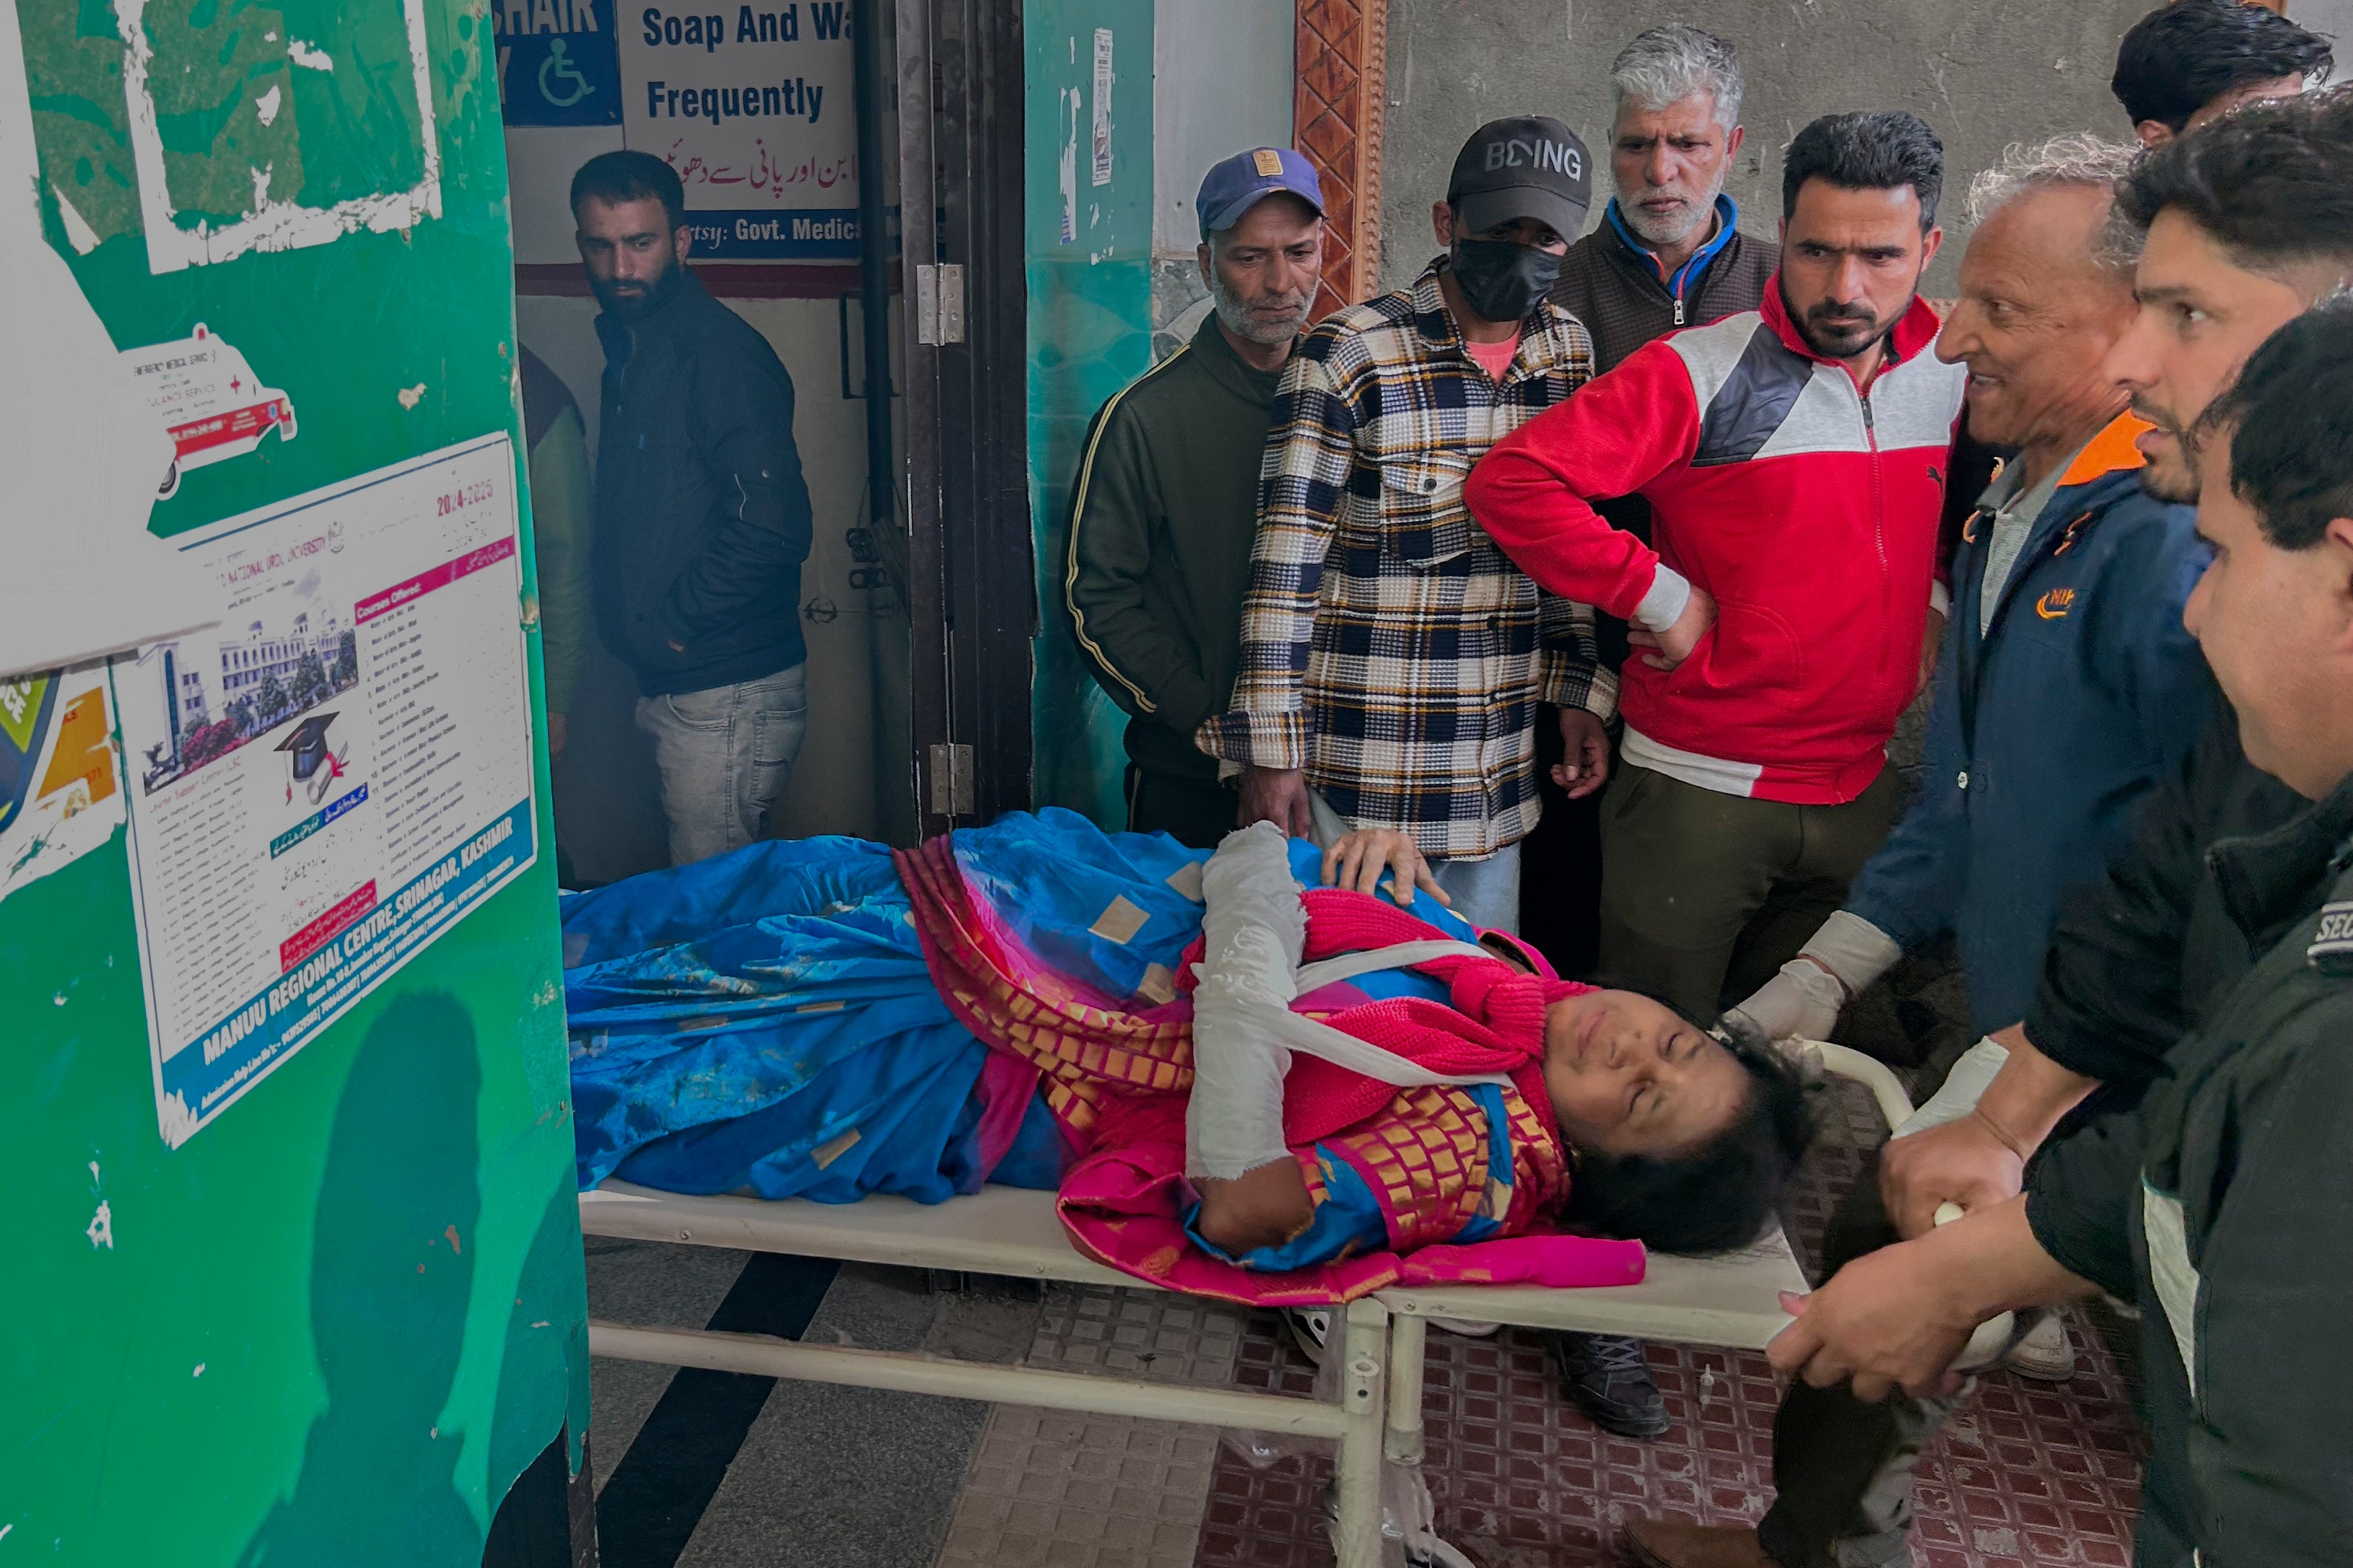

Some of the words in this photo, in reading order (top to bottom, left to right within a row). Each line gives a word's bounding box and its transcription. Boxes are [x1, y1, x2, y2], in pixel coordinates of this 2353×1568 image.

[494, 0, 598, 35] HAIR
[642, 8, 724, 53] Soap
[736, 4, 798, 43] And
[647, 77, 823, 126] Frequently
[689, 227, 728, 250] rtsy:
[735, 219, 785, 240] Govt.
[357, 597, 390, 619] Courses
[204, 997, 266, 1066] MANUU
[269, 942, 344, 1016] REGIONAL
[460, 816, 513, 870] KASHMIR
